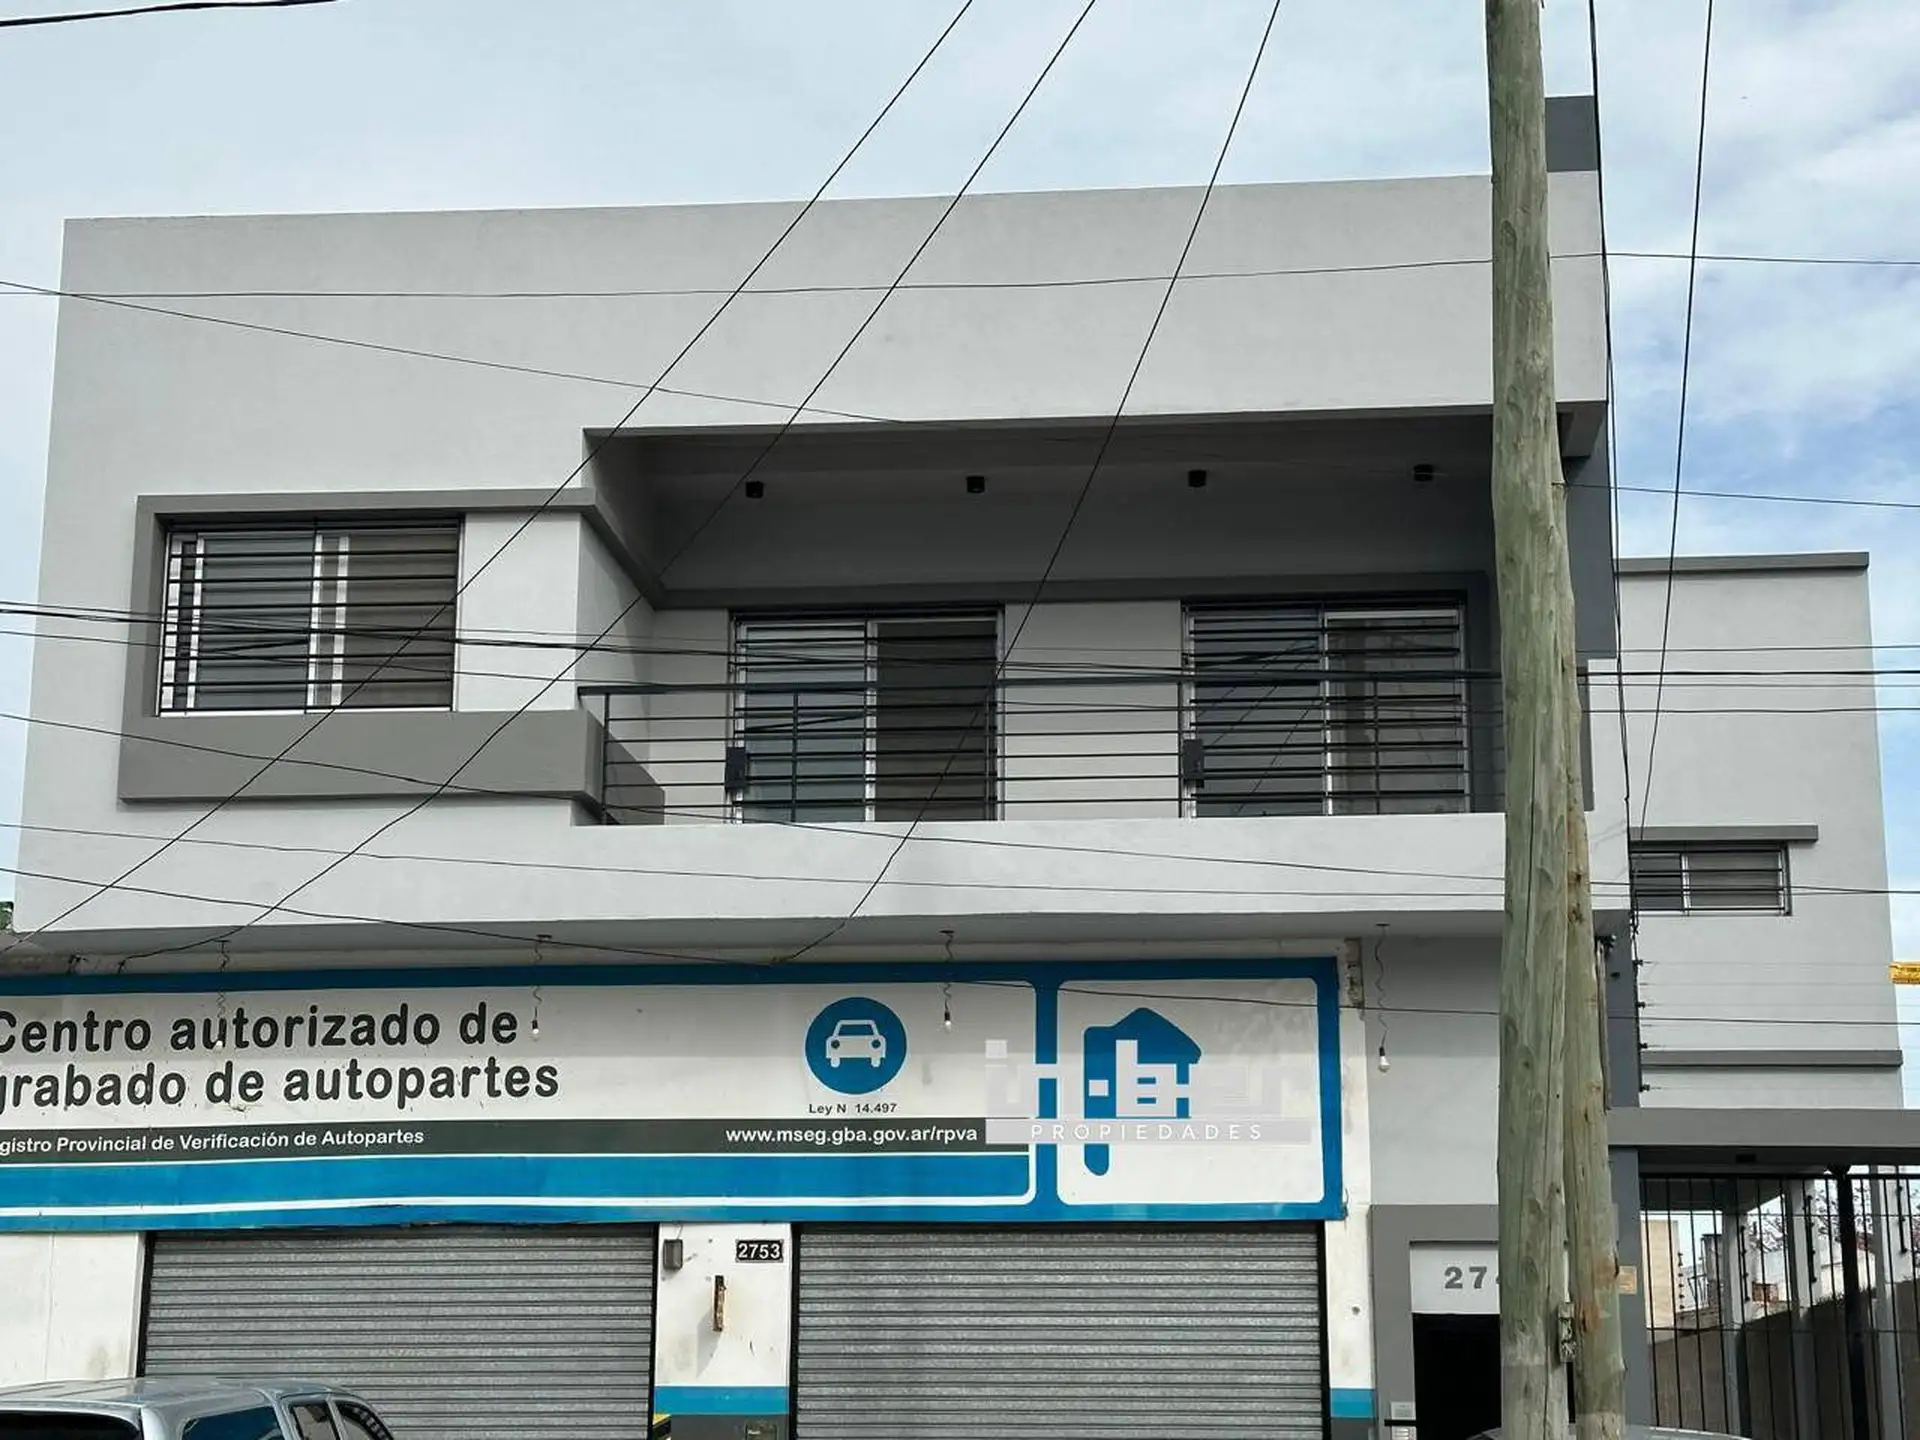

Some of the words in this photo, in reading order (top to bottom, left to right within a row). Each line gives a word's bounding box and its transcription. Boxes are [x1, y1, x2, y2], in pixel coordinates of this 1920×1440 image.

[170, 1002, 441, 1051] autorizado
[459, 1001, 518, 1046] de
[0, 1061, 187, 1115] rabado
[205, 1060, 265, 1104] de
[283, 1055, 560, 1110] autopartes
[808, 1102, 833, 1116] Ley
[836, 1102, 848, 1113] N
[854, 1102, 898, 1114] 14.497
[56, 1136, 147, 1153] Provincial
[151, 1135, 175, 1151] de
[179, 1131, 289, 1150] Verificación
[293, 1131, 317, 1146] de
[321, 1128, 425, 1147] Autopartes
[725, 1125, 979, 1146] www.mseg.gba.gov.ar/rpva
[738, 1243, 780, 1259] 2753
[1444, 1265, 1500, 1290] 27
